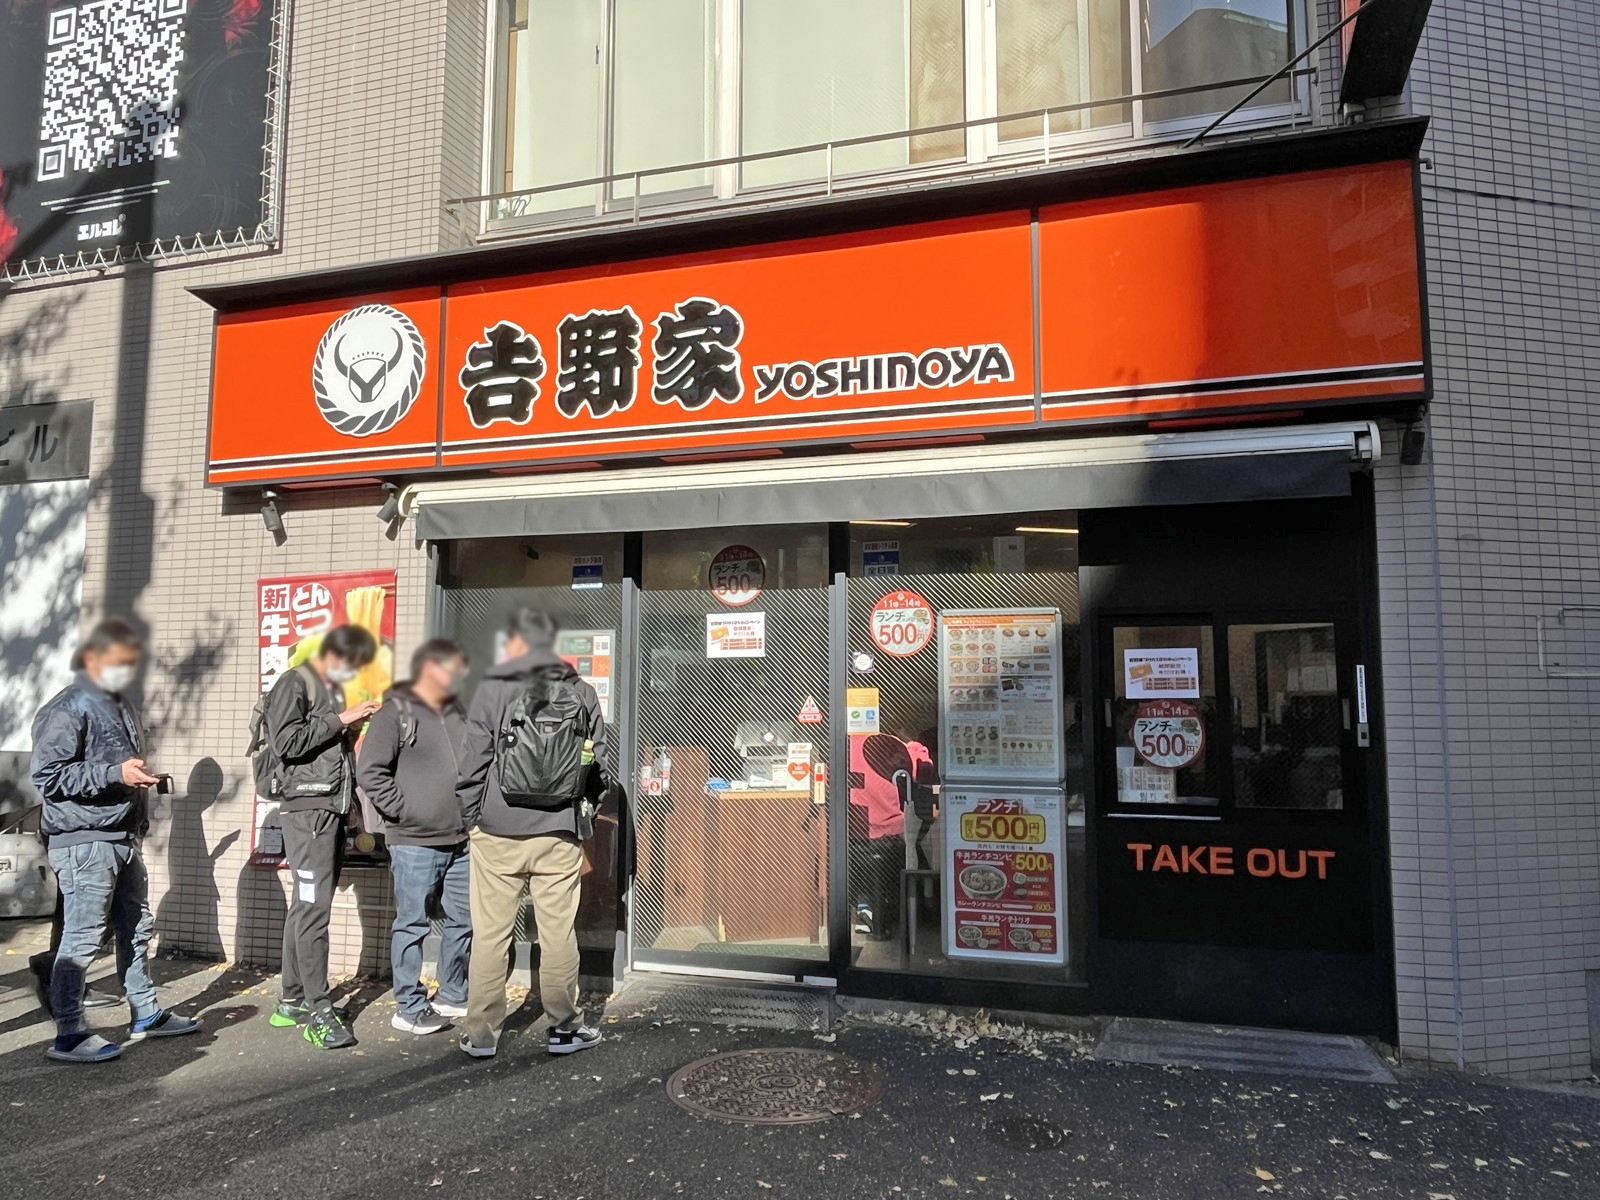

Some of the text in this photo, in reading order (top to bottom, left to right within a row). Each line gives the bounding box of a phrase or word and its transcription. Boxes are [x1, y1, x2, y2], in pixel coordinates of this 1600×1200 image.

[459, 297, 744, 428] 吉野家
[263, 586, 288, 610] 新
[876, 611, 906, 622] ランチ
[1137, 720, 1173, 733] ランチ
[1127, 843, 1336, 880] TAKE OUT
